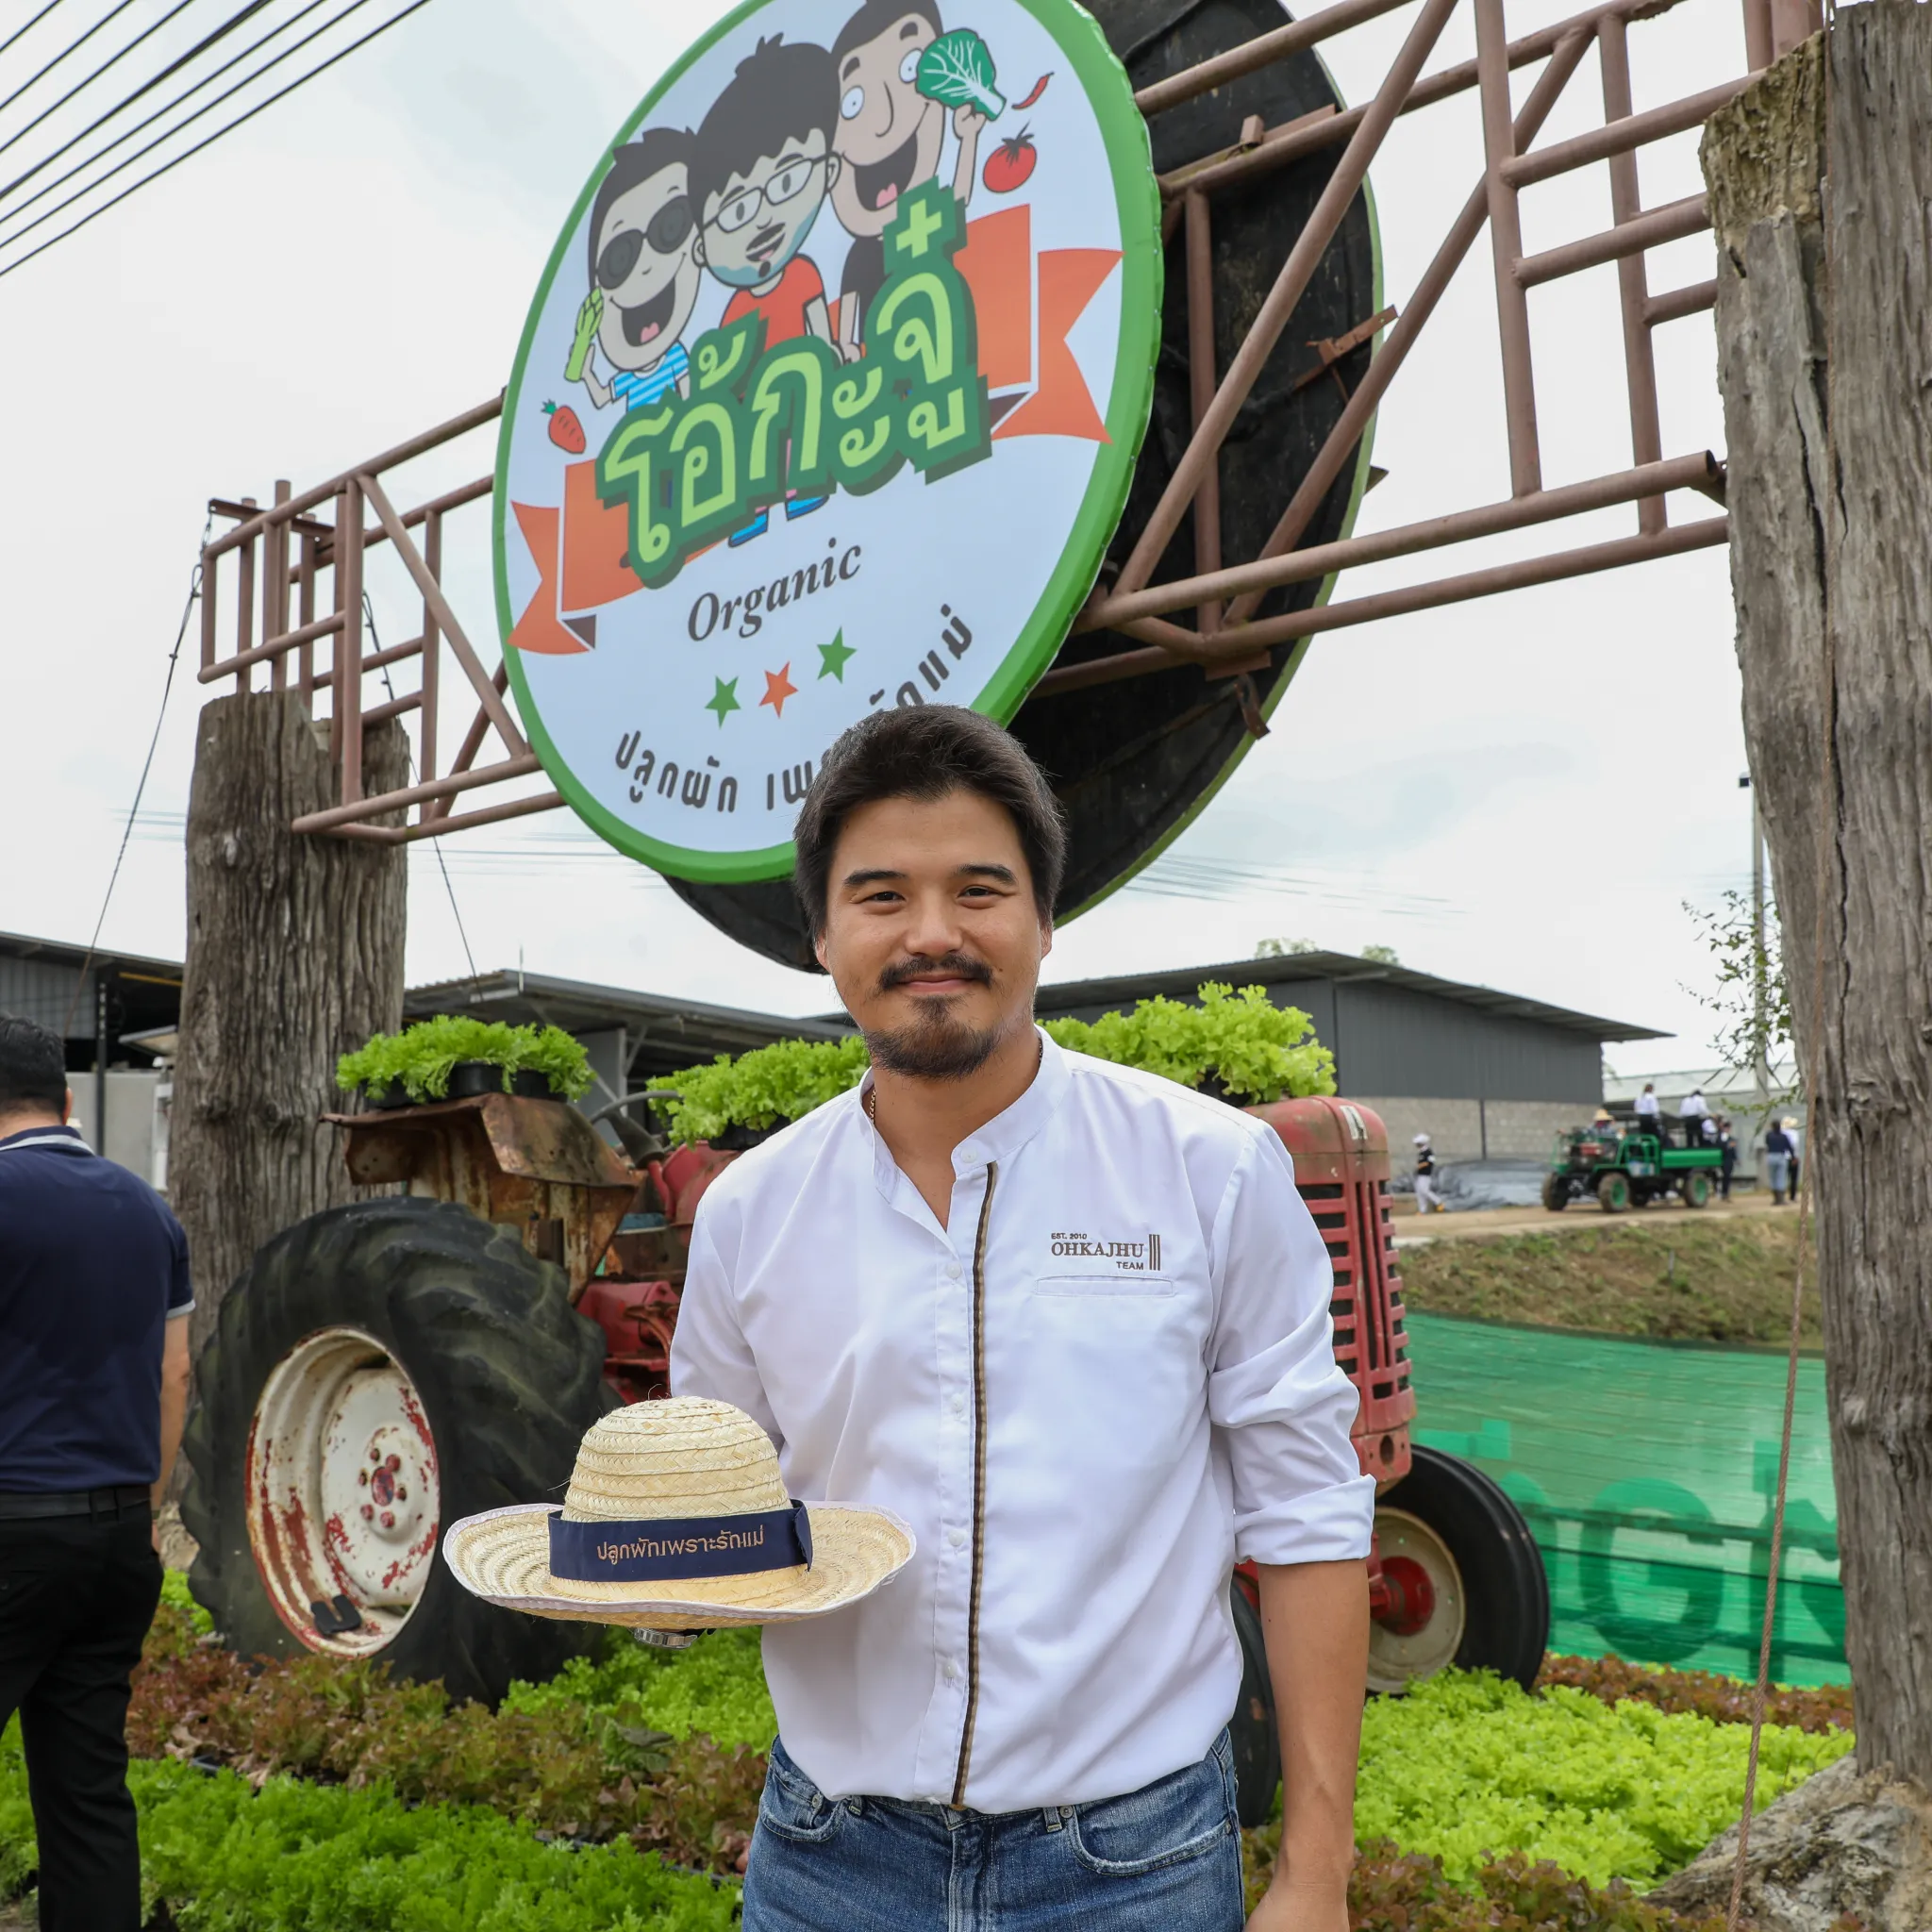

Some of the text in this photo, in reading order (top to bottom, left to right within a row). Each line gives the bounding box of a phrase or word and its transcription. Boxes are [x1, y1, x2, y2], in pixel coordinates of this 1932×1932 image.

[602, 195, 970, 566] โอ้กะจู๋
[687, 537, 862, 642] Organic
[615, 730, 739, 813] ปลูกผัก
[1050, 1232, 1088, 1241] EST. 2010
[1050, 1241, 1145, 1258] OHKAJHU
[1116, 1261, 1144, 1271] TEAM
